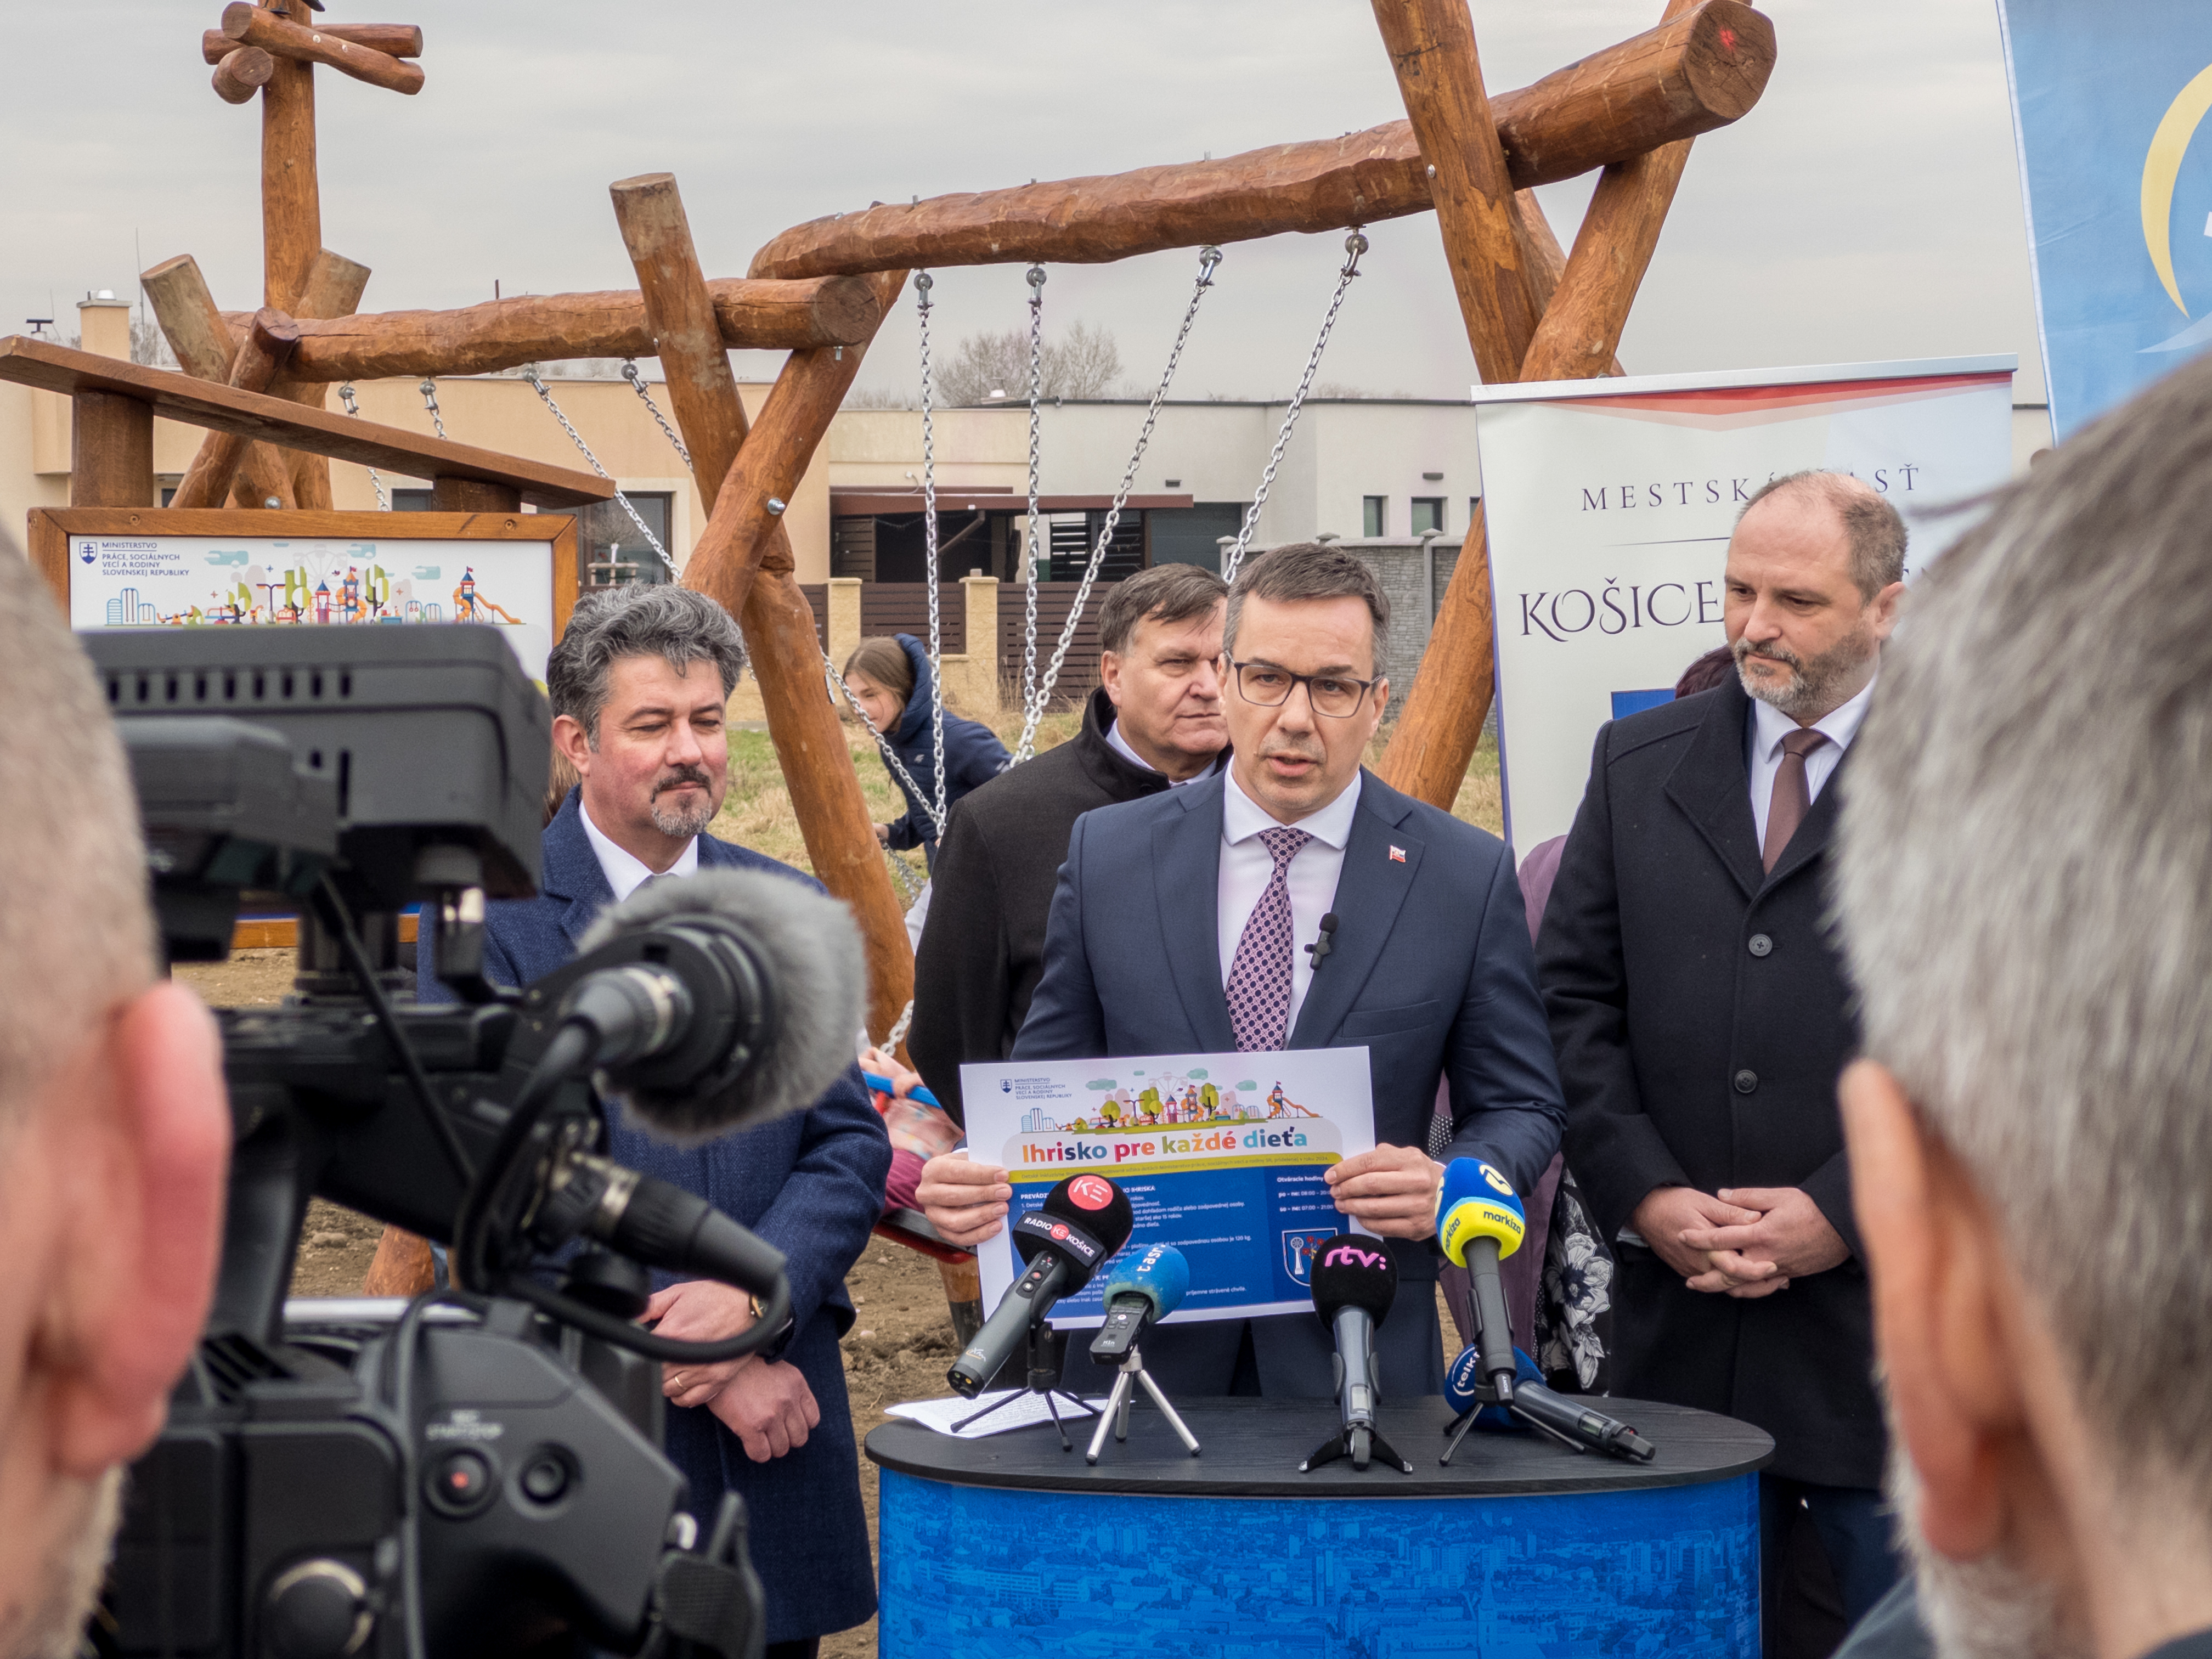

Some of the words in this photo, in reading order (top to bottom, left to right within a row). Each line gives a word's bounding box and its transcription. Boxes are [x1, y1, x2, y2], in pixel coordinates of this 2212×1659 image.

[102, 552, 128, 561] PRÁCE,
[1518, 577, 1724, 642] KOŠICE
[1022, 1141, 1107, 1163] Ihrisko
[1114, 1142, 1155, 1163] pre
[1161, 1131, 1236, 1154] každé
[1243, 1126, 1307, 1148] dieťa
[1483, 1210, 1521, 1234] markiza
